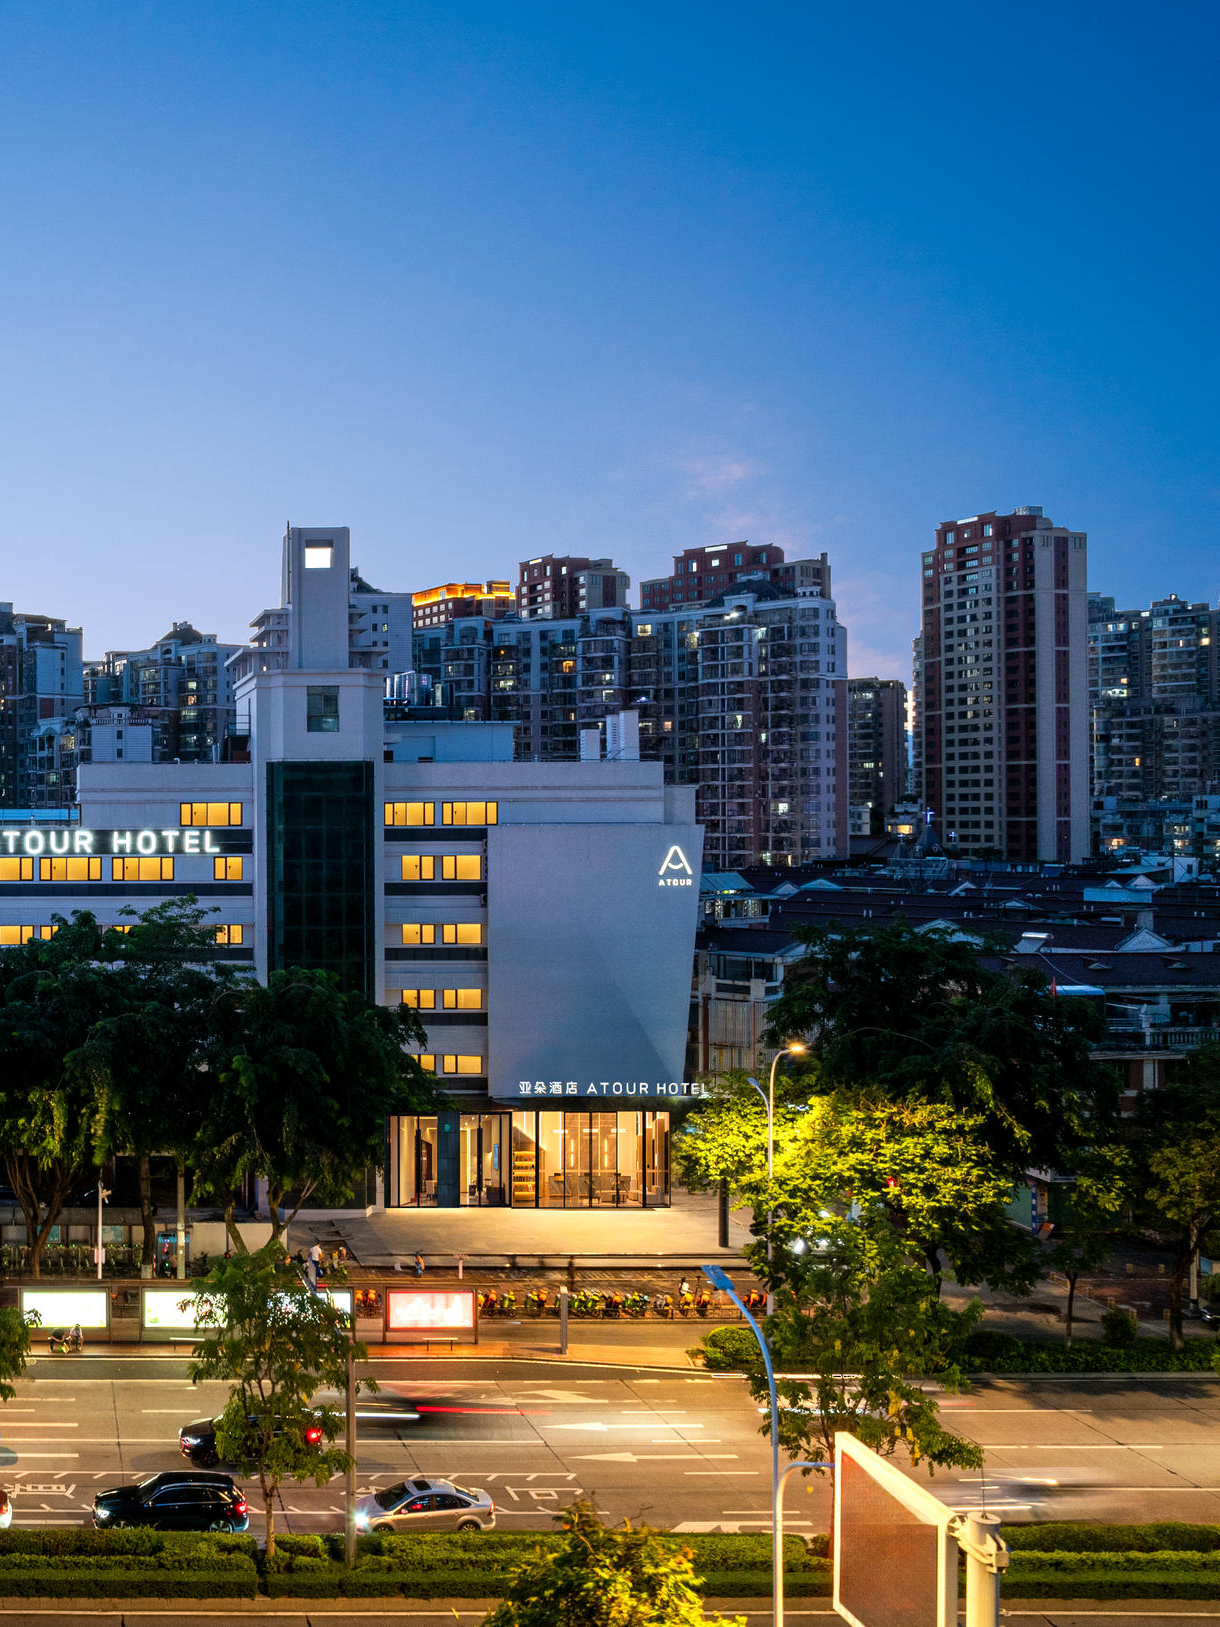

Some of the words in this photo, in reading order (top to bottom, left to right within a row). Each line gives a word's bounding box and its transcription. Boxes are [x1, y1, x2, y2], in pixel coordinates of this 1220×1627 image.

[112, 830, 220, 854] HOTEL
[658, 878, 692, 886] ATOUR
[519, 1081, 578, 1095] 亚朵酒店
[586, 1082, 649, 1095] ATOUR
[657, 1082, 710, 1095] HOTEL
